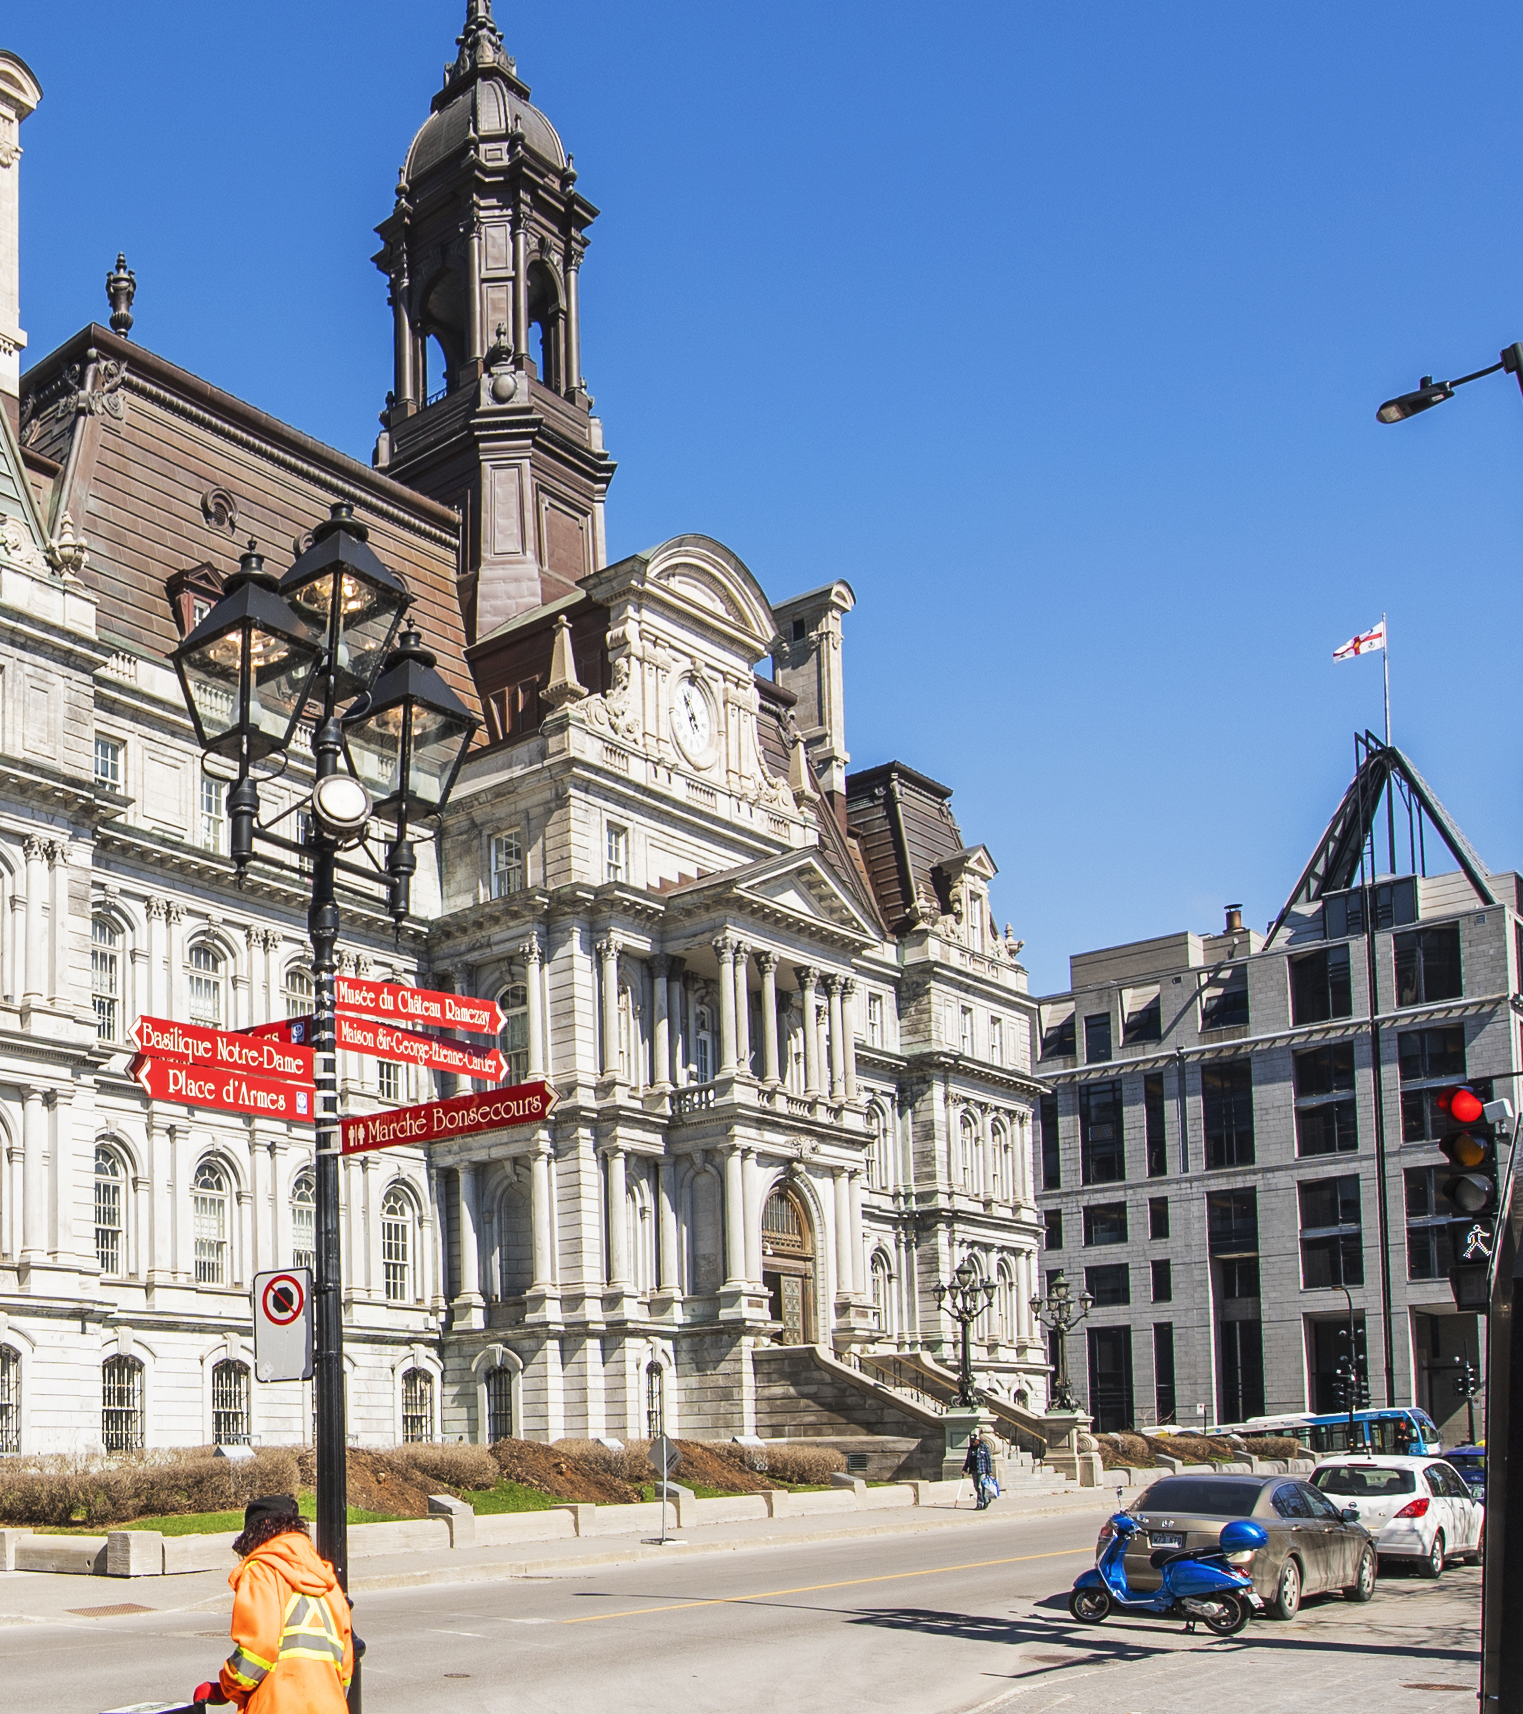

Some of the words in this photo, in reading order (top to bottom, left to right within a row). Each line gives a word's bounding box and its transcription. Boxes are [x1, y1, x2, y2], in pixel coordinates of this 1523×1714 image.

[339, 980, 375, 1008] Musée
[379, 987, 394, 1011] du
[398, 990, 441, 1018] Château
[445, 998, 491, 1033] Ramezay
[142, 1022, 212, 1063] Basilique
[216, 1036, 304, 1075] Notre-Dame
[341, 1020, 375, 1048] Maison
[168, 1069, 216, 1099] Place
[222, 1078, 286, 1111] d'Armes
[367, 1110, 428, 1144] Marché
[432, 1094, 543, 1132] Bonsecours
